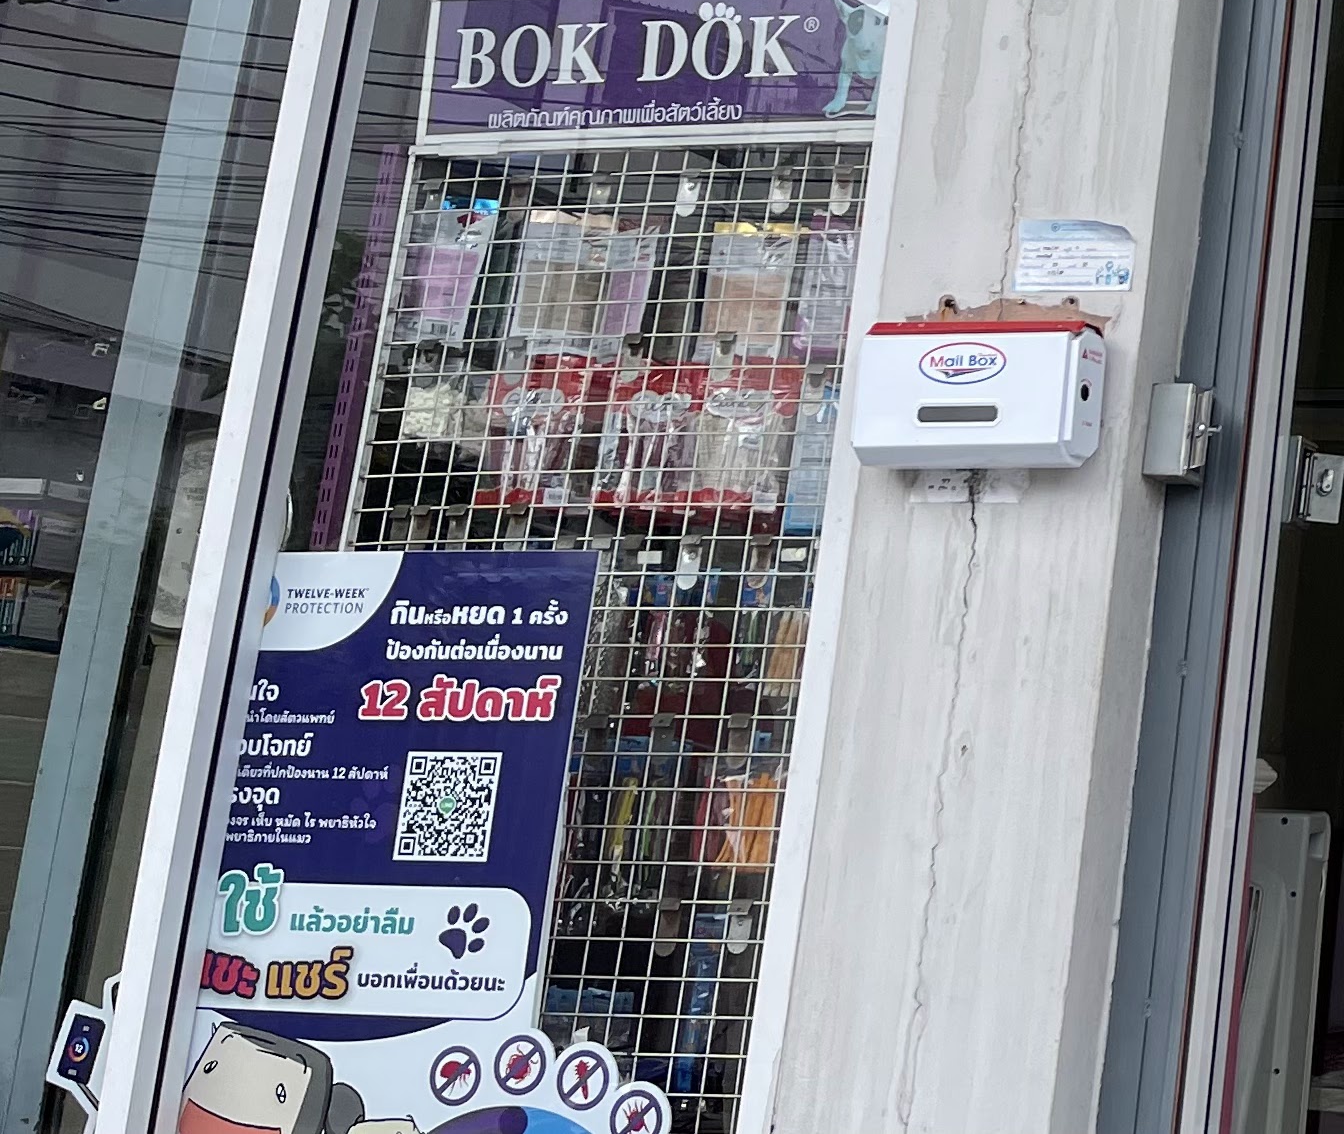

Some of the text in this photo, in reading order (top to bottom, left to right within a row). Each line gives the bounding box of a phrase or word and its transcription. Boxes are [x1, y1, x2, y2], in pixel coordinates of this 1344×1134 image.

[451, 21, 608, 90] BOK
[487, 96, 743, 130] ผลิตภัณฑ์คุณภาพเพื่อสัตว์เลี้ยง
[929, 354, 998, 368] Mail Box
[287, 588, 366, 599] TWELVE-WEEK
[284, 601, 364, 614] PROTECTION
[511, 607, 524, 625] 1
[528, 599, 569, 625] ครั้ง
[385, 633, 564, 660] ป้องกันต่อเนื่องนาน
[357, 673, 562, 723] 12 สัปดาห์
[331, 767, 347, 780] 12
[347, 766, 389, 781] สัปดาห์
[229, 816, 249, 827] งจร
[251, 811, 272, 827] เห็บ
[304, 811, 316, 828] ไร
[218, 863, 415, 936] ใช้ แล้วอย่าลืม
[266, 946, 354, 999] แชร์
[357, 963, 505, 992] บอกเพื่อนด้วยนะ
